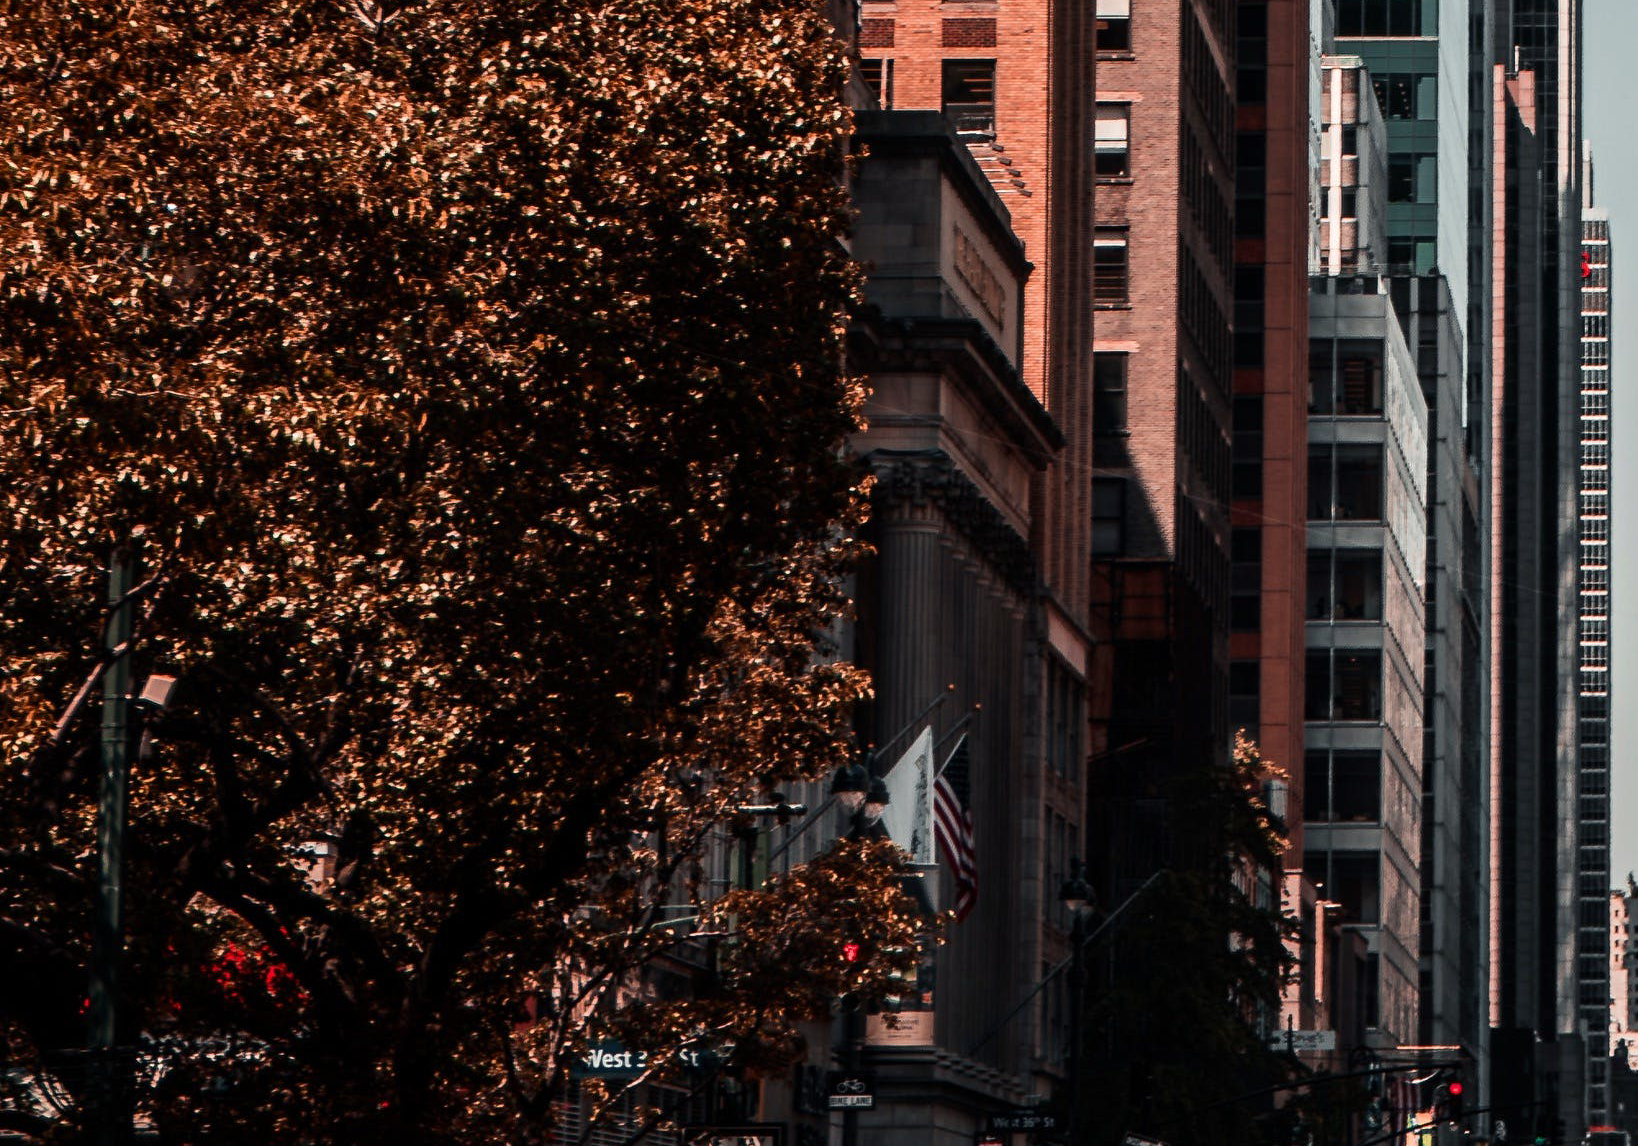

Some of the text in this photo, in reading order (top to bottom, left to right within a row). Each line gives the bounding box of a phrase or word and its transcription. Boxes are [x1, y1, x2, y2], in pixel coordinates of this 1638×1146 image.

[829, 1096, 872, 1107] BIKE LANE
[993, 1117, 1019, 1128] Wet
